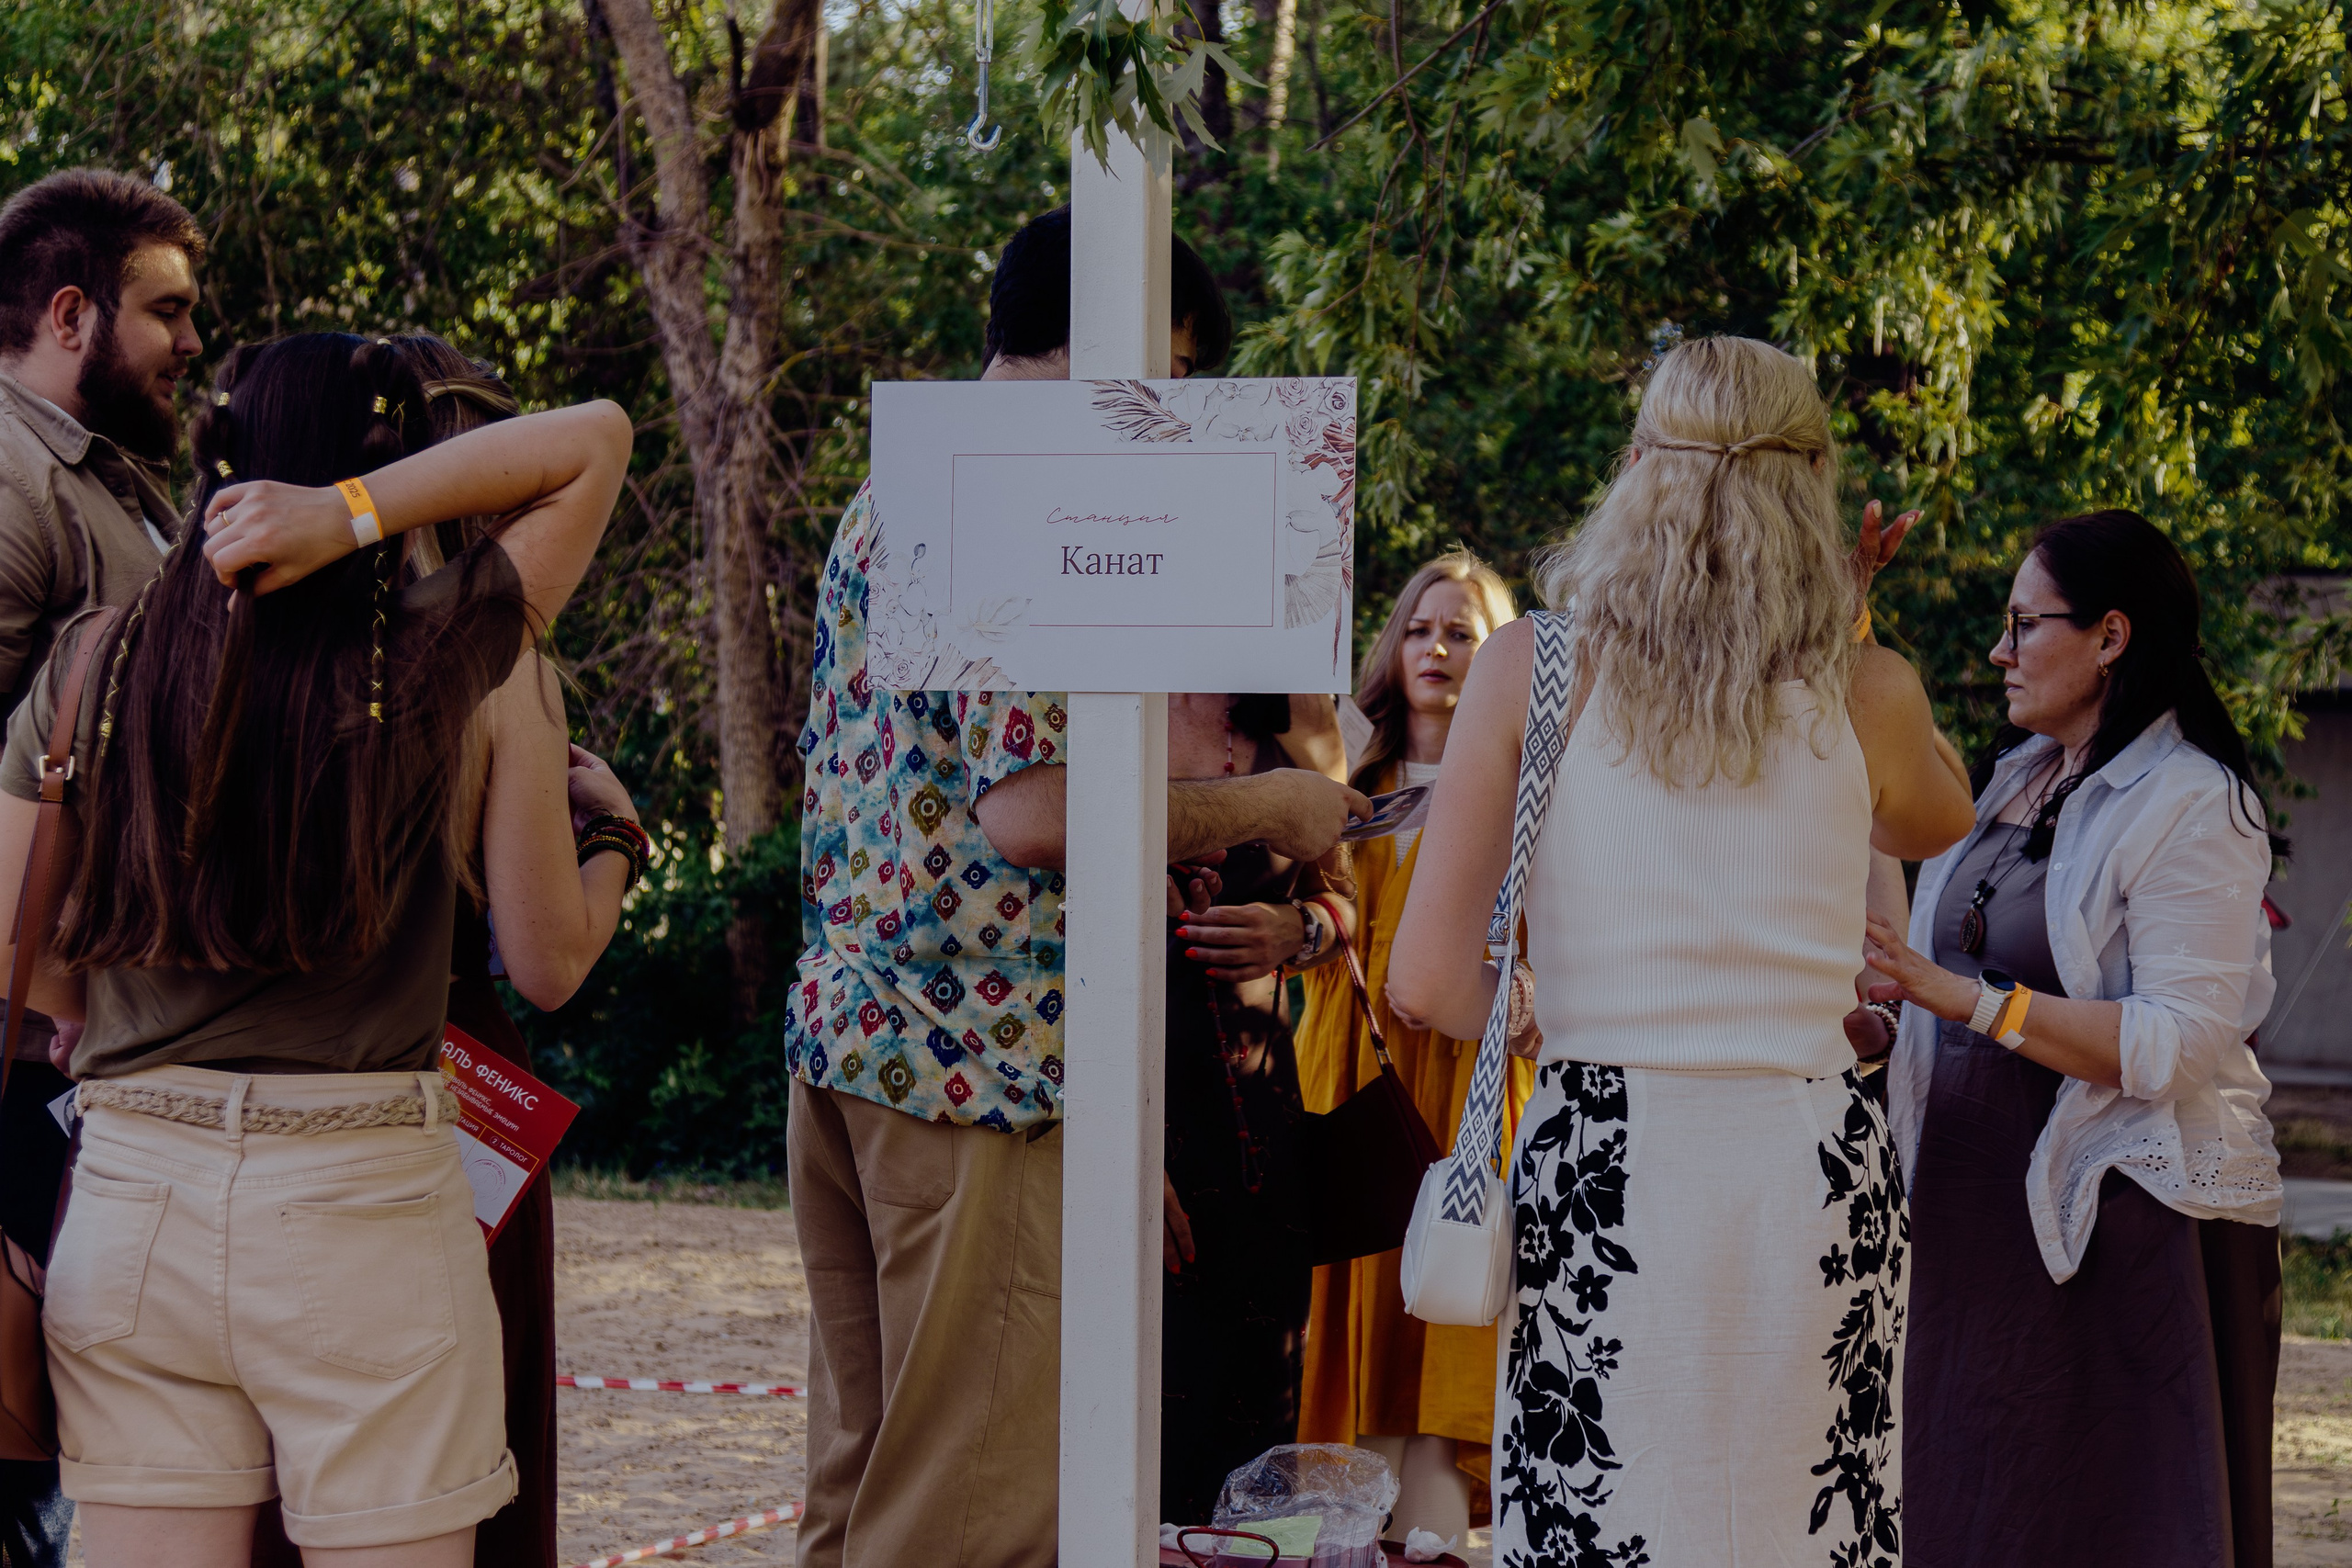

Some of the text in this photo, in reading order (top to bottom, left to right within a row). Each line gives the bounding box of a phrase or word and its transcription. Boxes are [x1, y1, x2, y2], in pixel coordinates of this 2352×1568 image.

[345, 482, 360, 498] 2025
[1046, 507, 1178, 525] Станция
[1061, 547, 1163, 575] Канат
[439, 1042, 538, 1110] АЛЬ ФЕНИКС
[468, 1088, 492, 1107] ФЕНИКС,
[450, 1085, 493, 1114] НЕЗАБЫВАЕМЫЕ
[493, 1112, 519, 1131] ЭМОЦИИ!
[457, 1115, 479, 1132] ТАЦИЯ
[500, 1143, 527, 1163] ТАРОЛОГ
